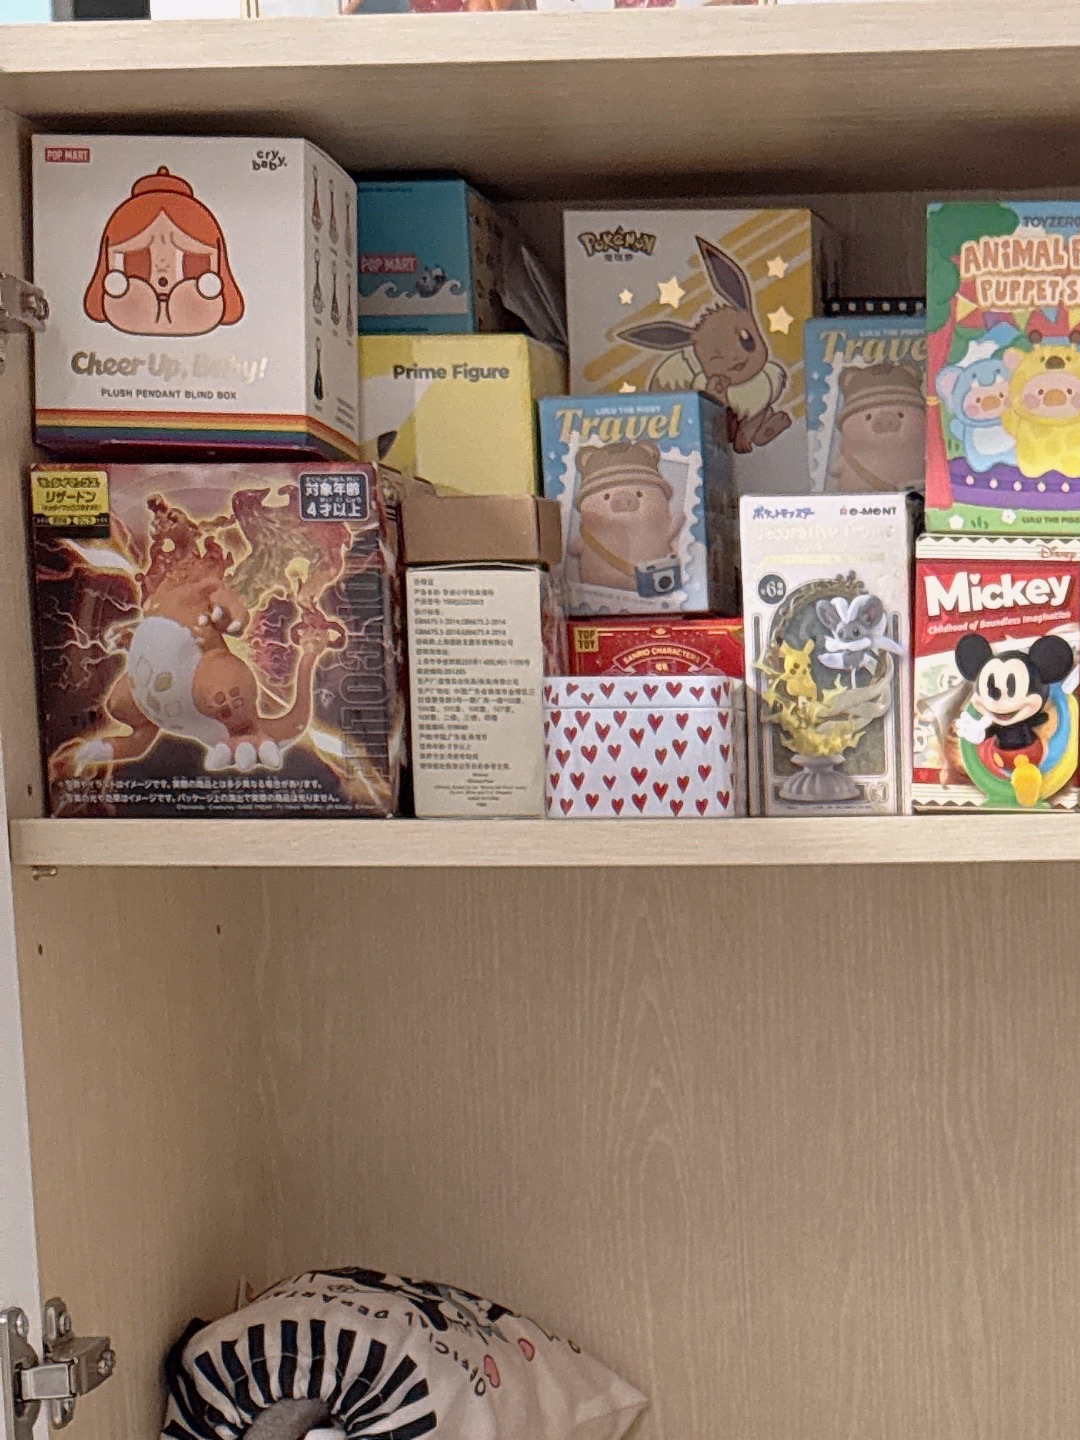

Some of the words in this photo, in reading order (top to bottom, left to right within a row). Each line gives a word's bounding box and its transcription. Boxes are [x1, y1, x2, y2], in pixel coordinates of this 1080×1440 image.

[47, 150, 63, 161] POP
[65, 150, 88, 161] MART
[256, 150, 279, 162] cry
[361, 255, 383, 272] POP
[385, 256, 416, 272] MART
[979, 278, 1060, 304] PUPPET
[820, 329, 928, 364] Trave
[71, 351, 146, 376] Cheer
[393, 365, 447, 380] Prime
[452, 364, 510, 385] Figure
[101, 388, 133, 398] PLUSH
[136, 389, 180, 399] PENDANT
[185, 390, 213, 400] BLIND
[217, 391, 236, 400] BOX
[556, 403, 682, 443] Travel
[306, 482, 360, 497] 対象年齢
[924, 571, 1072, 618] Mickey
[928, 622, 967, 636] Childhood
[969, 620, 979, 631] of
[980, 616, 1021, 630] Boundless
[1023, 611, 1072, 625] Imagination
[404, 1311, 487, 1397] OFFICIAL
